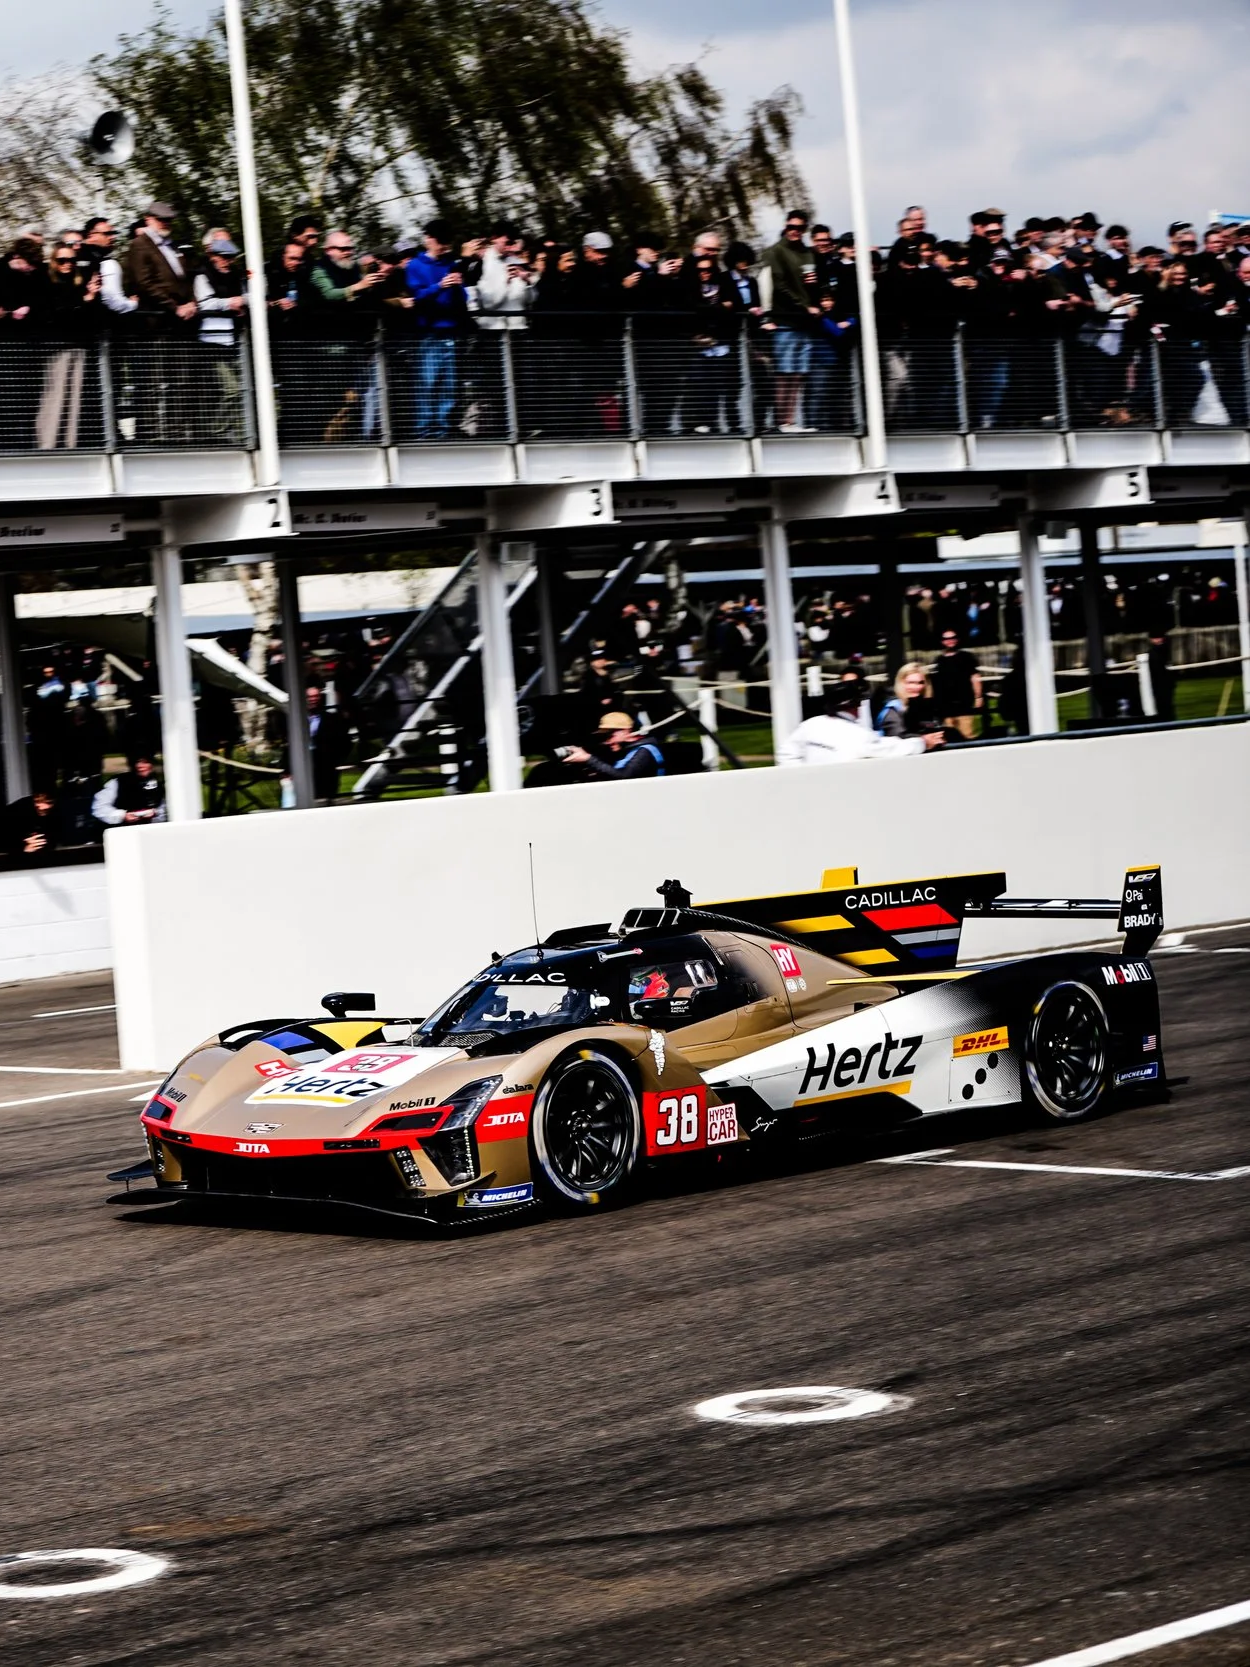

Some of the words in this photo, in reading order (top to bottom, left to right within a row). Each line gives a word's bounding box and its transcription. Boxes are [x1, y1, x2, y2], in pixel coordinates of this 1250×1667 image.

[876, 479, 891, 505] 4
[1126, 471, 1140, 498] 5
[266, 497, 282, 528] 2
[589, 487, 602, 517] 3
[845, 886, 937, 910] CADILLAC
[1123, 912, 1157, 929] BRADY
[773, 948, 797, 972] HY
[472, 973, 567, 983] DILLAC
[1101, 962, 1138, 986] Mobil
[1136, 962, 1152, 981] 1
[961, 1032, 1002, 1052] DHL
[798, 1031, 924, 1095] Hertz
[1120, 1067, 1154, 1081] MICHELIN
[264, 1075, 392, 1097] Hertz
[389, 1098, 423, 1111] Mobil
[424, 1096, 436, 1106] 1
[708, 1106, 735, 1122] HYPER
[483, 1111, 526, 1127] JOTA
[656, 1093, 699, 1147] 38
[708, 1119, 737, 1142] CAR
[233, 1142, 271, 1154] JOTA
[481, 1188, 528, 1202] MICHELIN
